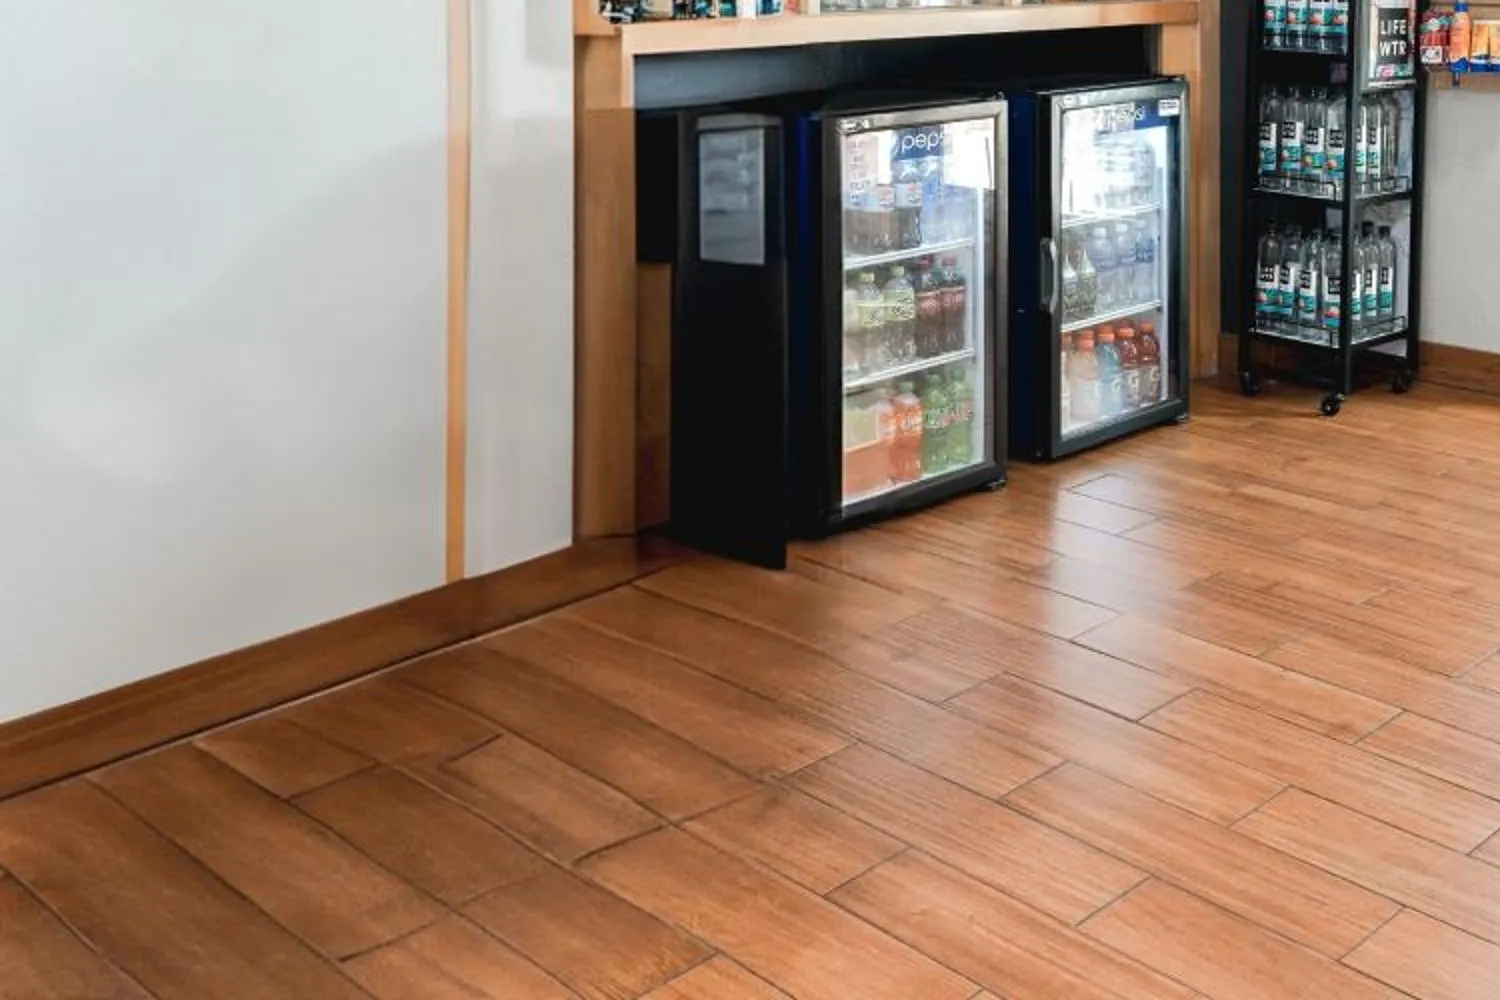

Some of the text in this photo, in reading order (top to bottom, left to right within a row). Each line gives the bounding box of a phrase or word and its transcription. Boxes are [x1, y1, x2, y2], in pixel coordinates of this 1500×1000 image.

[1380, 19, 1407, 36] LIFE
[1379, 41, 1406, 57] WTR
[901, 131, 944, 153] pep
